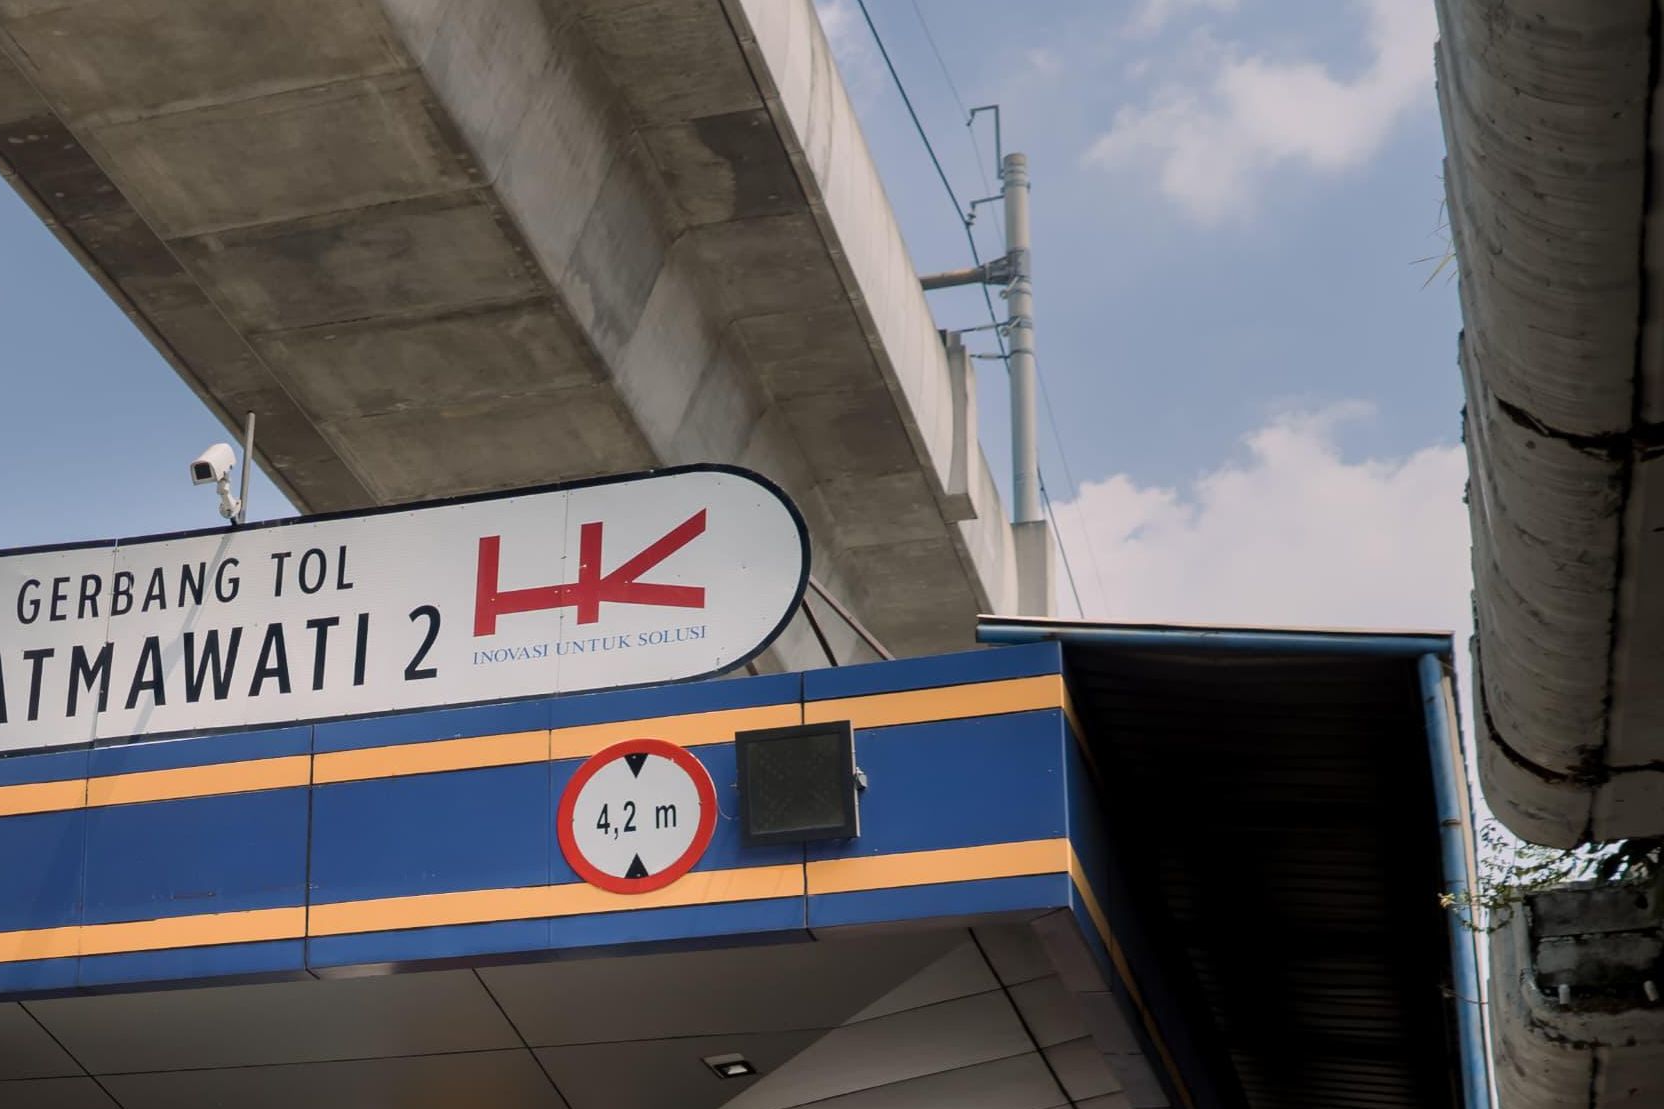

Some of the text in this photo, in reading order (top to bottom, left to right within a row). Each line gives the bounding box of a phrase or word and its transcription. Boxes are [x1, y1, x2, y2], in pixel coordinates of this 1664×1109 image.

[17, 545, 354, 625] GERBANG TOL
[473, 507, 707, 637] HK
[404, 604, 441, 682] 2
[472, 625, 707, 665] INOVASI UNTUK SOLUSI
[596, 801, 677, 840] 4,2 m
